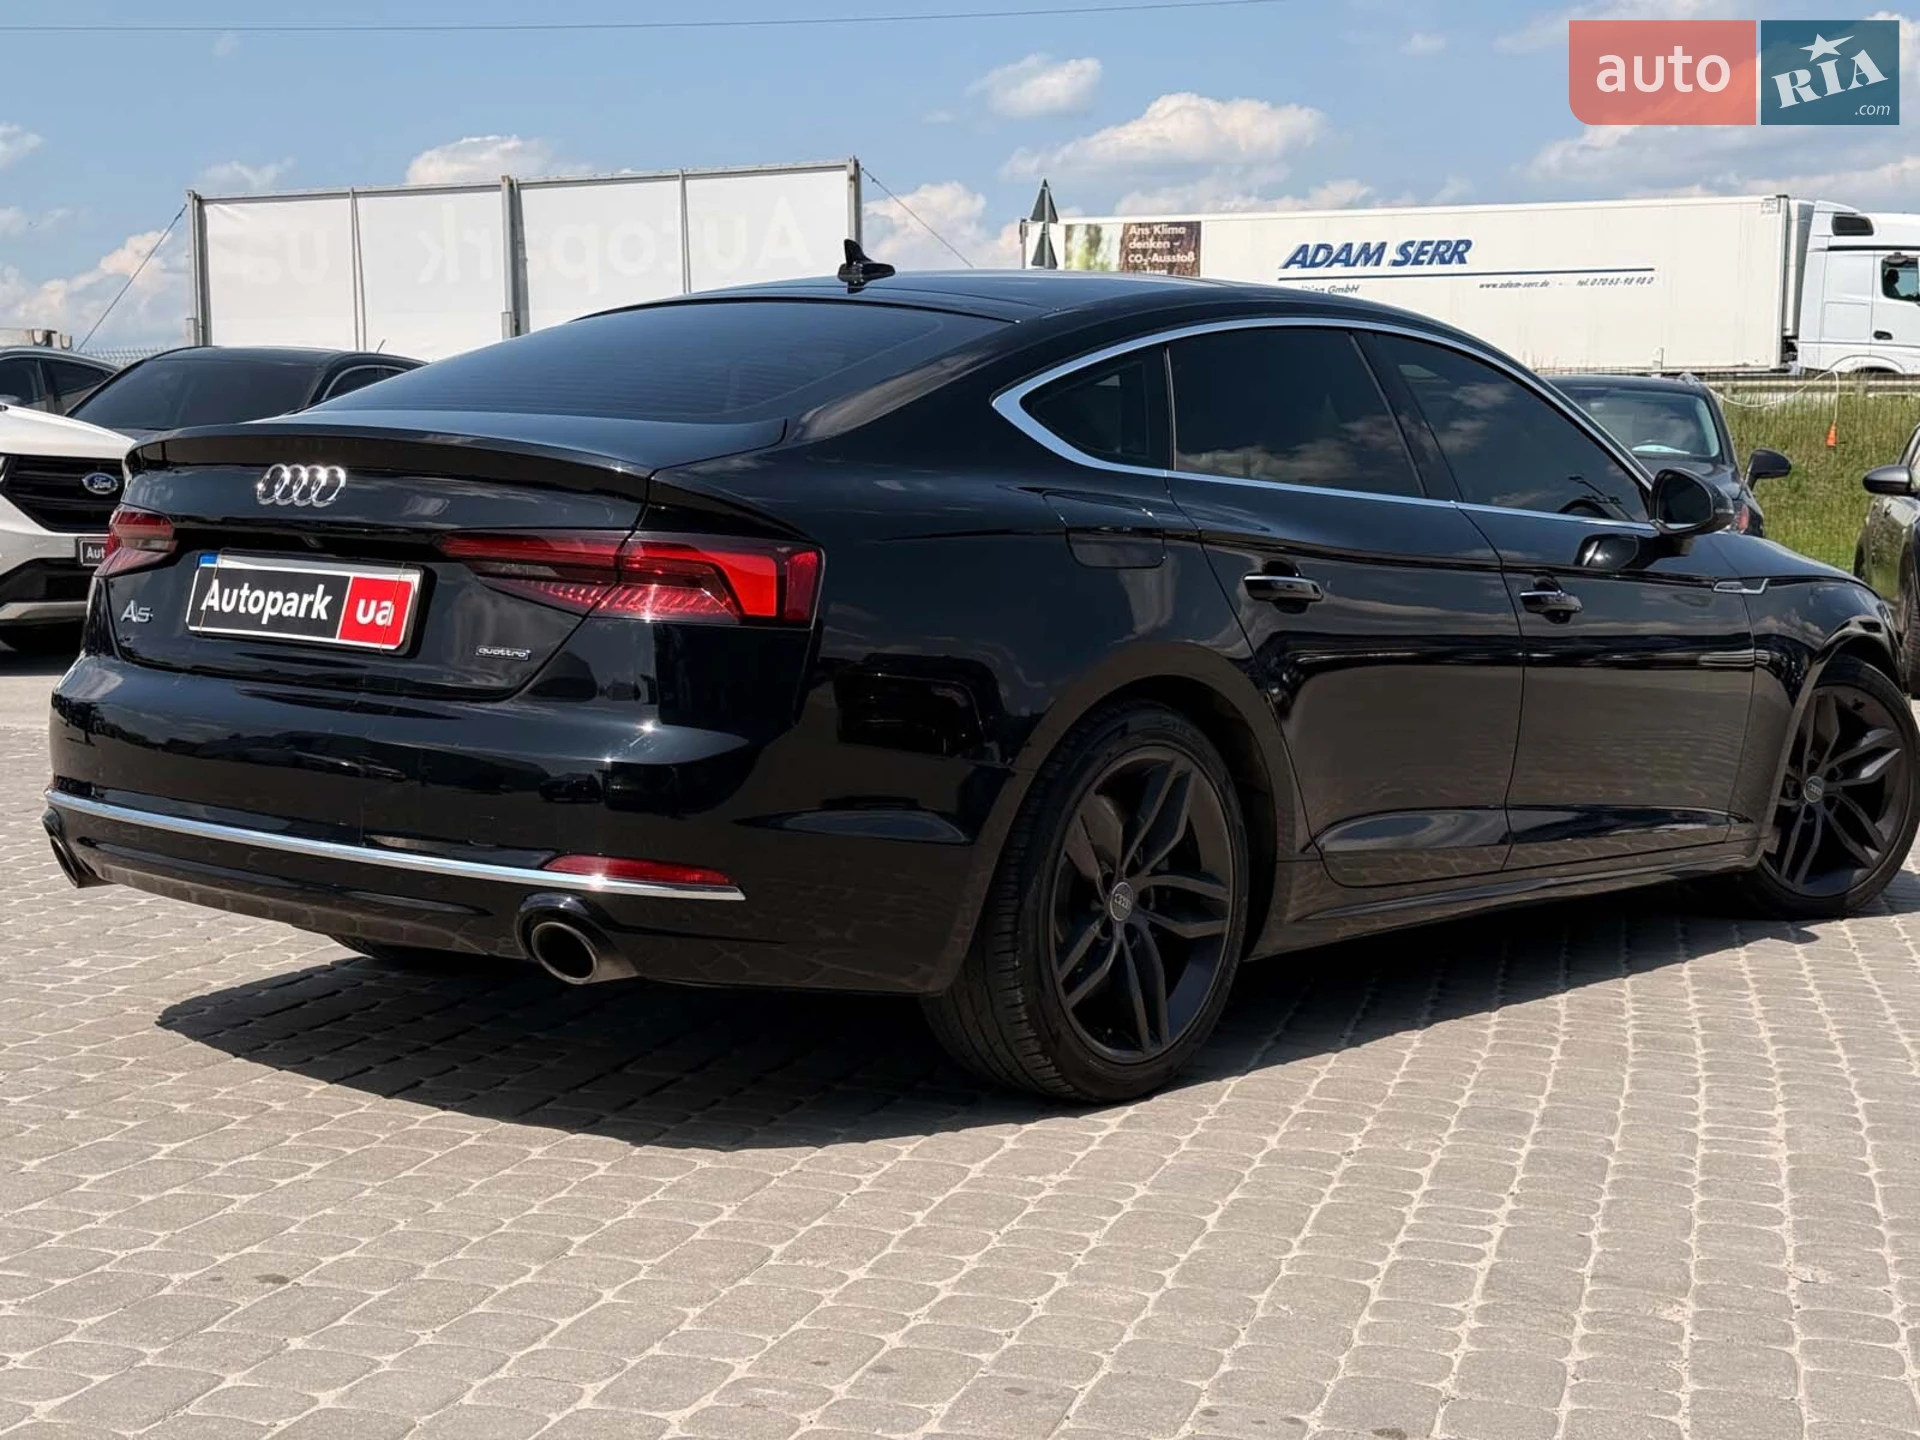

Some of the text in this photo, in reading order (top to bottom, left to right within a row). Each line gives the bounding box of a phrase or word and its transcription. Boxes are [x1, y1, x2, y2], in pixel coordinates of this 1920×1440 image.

[1128, 223, 1187, 235] Ans Klima
[1128, 237, 1171, 249] denken
[1278, 239, 1473, 270] ADAM SERR
[1327, 283, 1361, 294] GmbH
[86, 546, 106, 559] Aut
[200, 578, 396, 627] Autopark ua
[120, 599, 153, 623] A5
[478, 647, 530, 659] quattro
